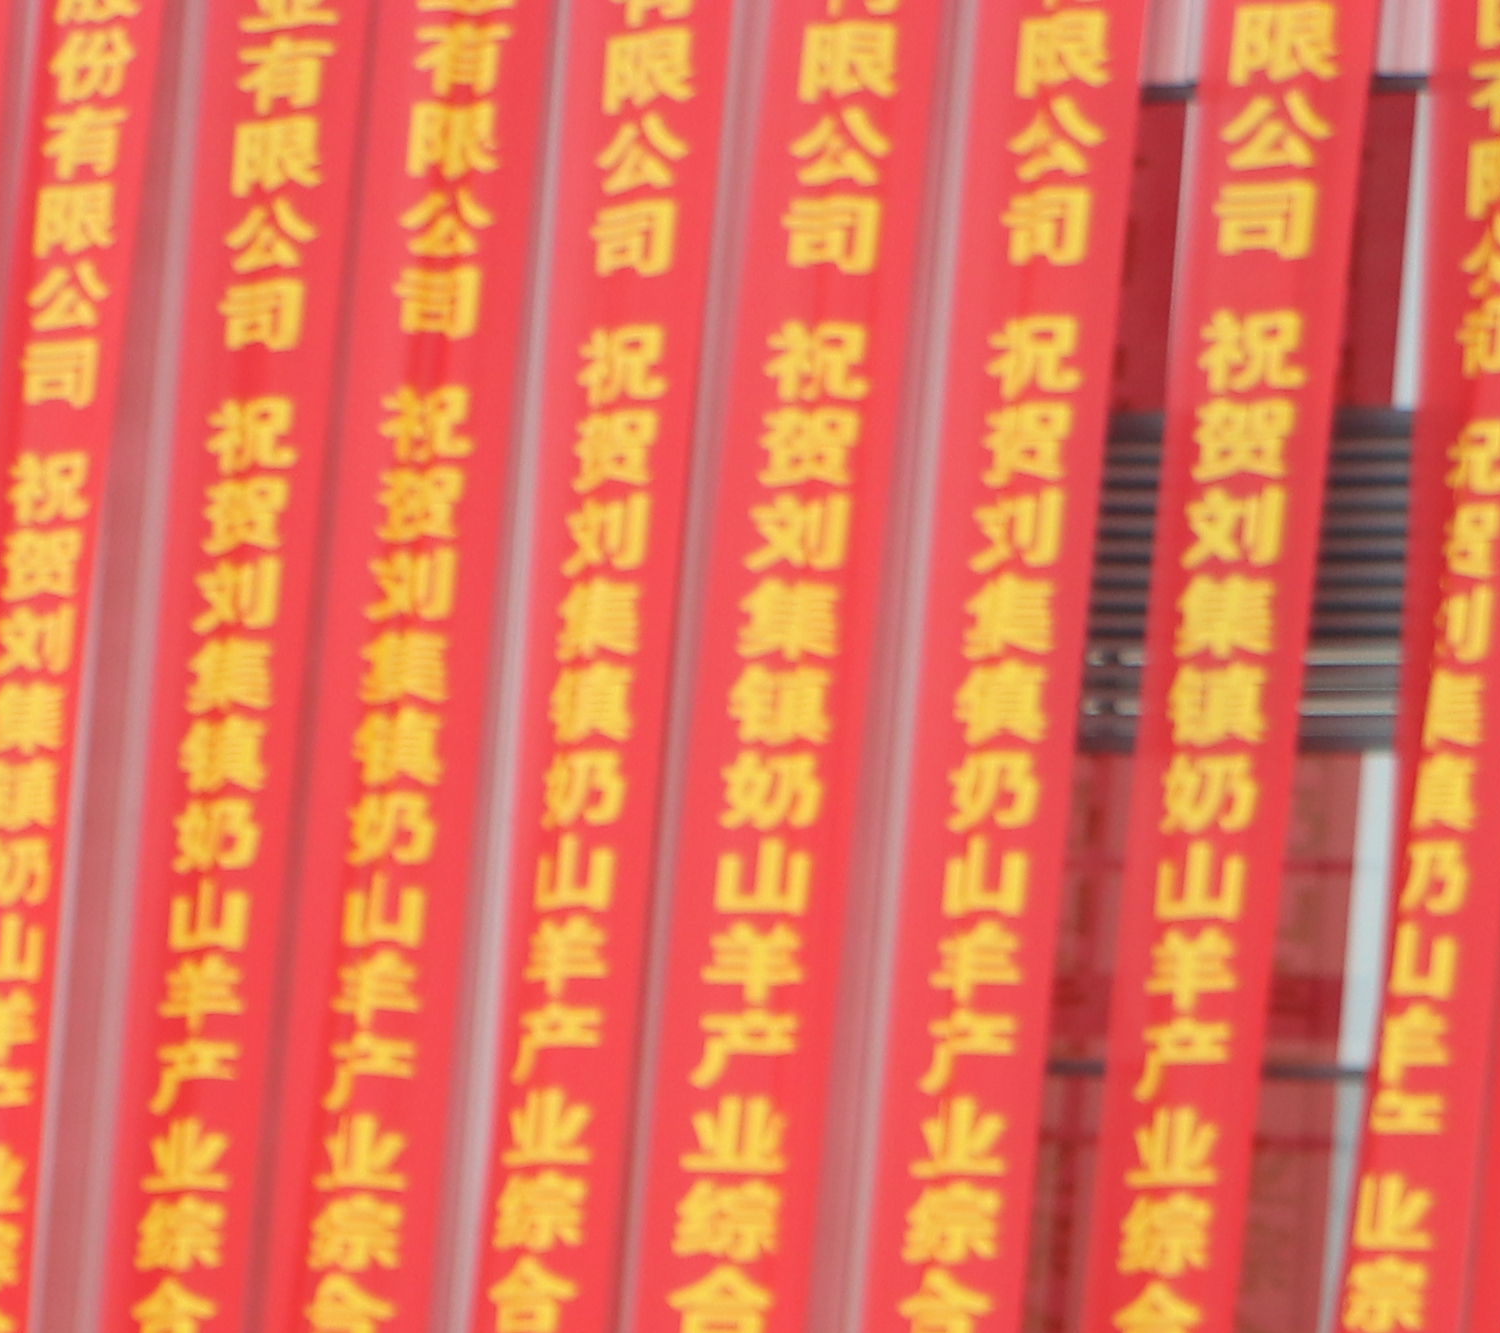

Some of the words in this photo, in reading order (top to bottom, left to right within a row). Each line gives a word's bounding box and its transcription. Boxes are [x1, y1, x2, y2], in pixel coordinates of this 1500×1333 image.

[396, 0, 514, 337] 有限公司
[784, 0, 898, 273] 限公司
[1004, 0, 1108, 264] 限公司
